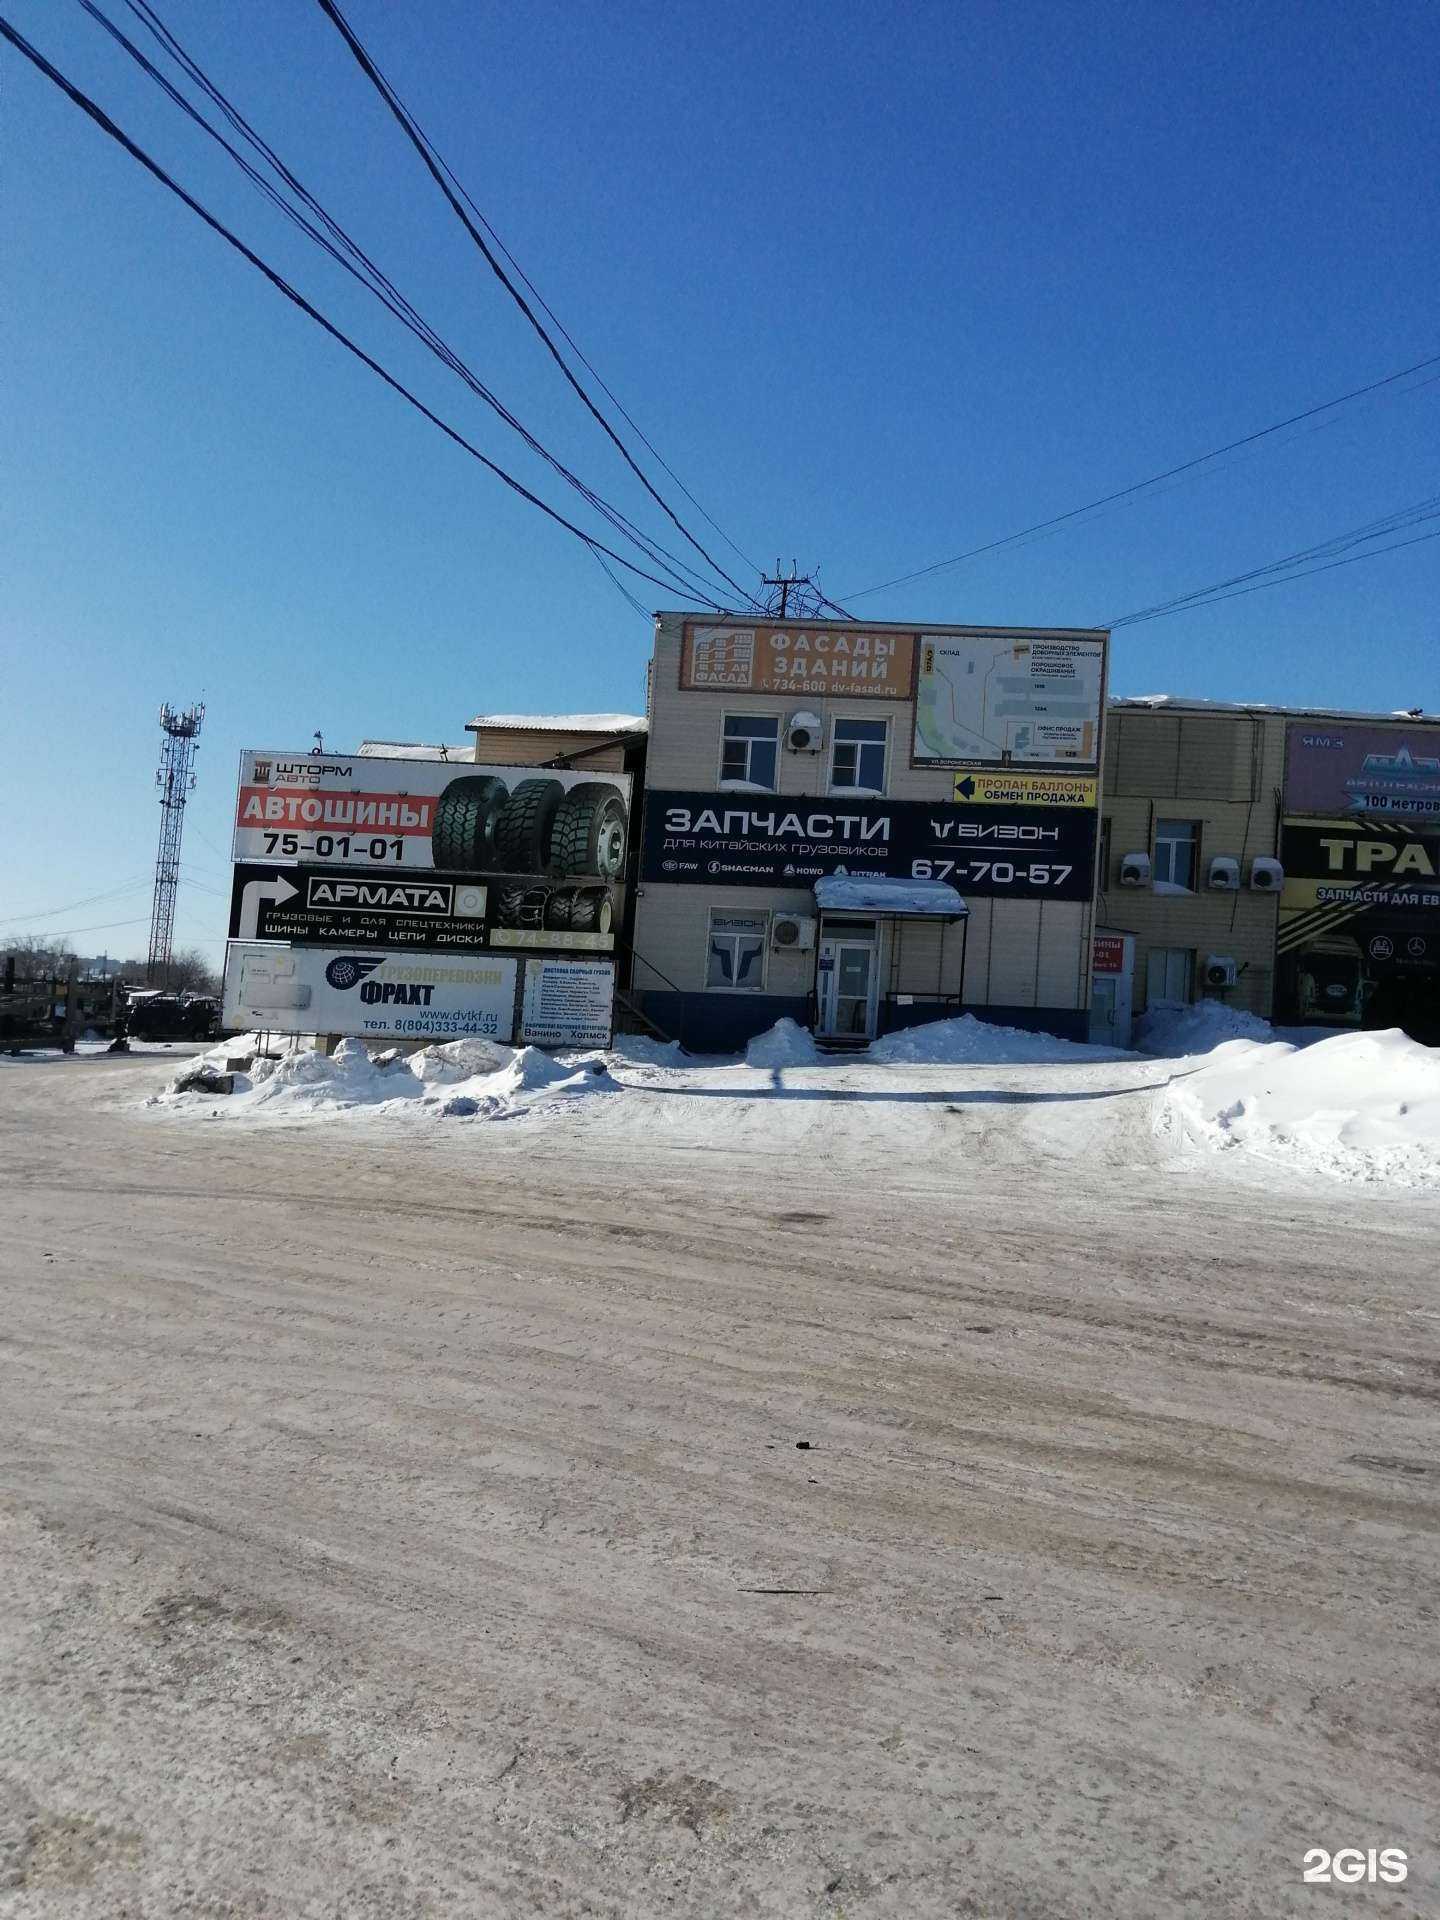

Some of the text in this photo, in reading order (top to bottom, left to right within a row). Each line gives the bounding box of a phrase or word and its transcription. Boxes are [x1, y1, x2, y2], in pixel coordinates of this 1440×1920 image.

[770, 633, 896, 657] ФАСАДЫ
[773, 656, 888, 679] ЗДАНИЙ
[695, 672, 748, 683] ФАСАД
[831, 682, 897, 696] dv-fasad.ru
[1302, 735, 1344, 748] ЯМЗ
[276, 763, 353, 777] ШТОРМ
[275, 774, 321, 784] АВТО
[977, 778, 1093, 793] ПРОПАН БАЛЛОНЫ
[984, 790, 1085, 804] ОБМЕН ПРОДАЖА
[1365, 795, 1440, 812] 100 метров
[243, 795, 430, 827] АВТОШИНЫ
[664, 808, 891, 840] ЗАПЧАСТИ
[958, 823, 1059, 841] БИЗОН
[263, 833, 405, 861] 75-01-01
[700, 840, 787, 852] китайских
[791, 844, 888, 857] грузовиков
[1320, 838, 1436, 876] ТРА
[679, 862, 698, 870] FAW
[721, 864, 774, 873] SHACMAN
[796, 867, 824, 875] HOWO
[911, 859, 1073, 885] 67-70-57
[312, 884, 447, 909] АРМАТА
[1316, 887, 1389, 903] ЗАПЧАСТИ
[1391, 893, 1419, 905] ДЛЯ
[265, 911, 485, 931] ГРУЗОВЫЕ И ДЛЯ СПЕЦТЕХНИКИ
[265, 925, 484, 944] ШИНЫ КАМЕРЫ ЦЕПИ ДИСКИ
[360, 980, 435, 1006] ФРАХТ
[420, 1010, 498, 1022] www.dvtkf.ru
[363, 1020, 498, 1035] тел. 8(804)333-44-32
[525, 1029, 608, 1040] Ванино Холмск
